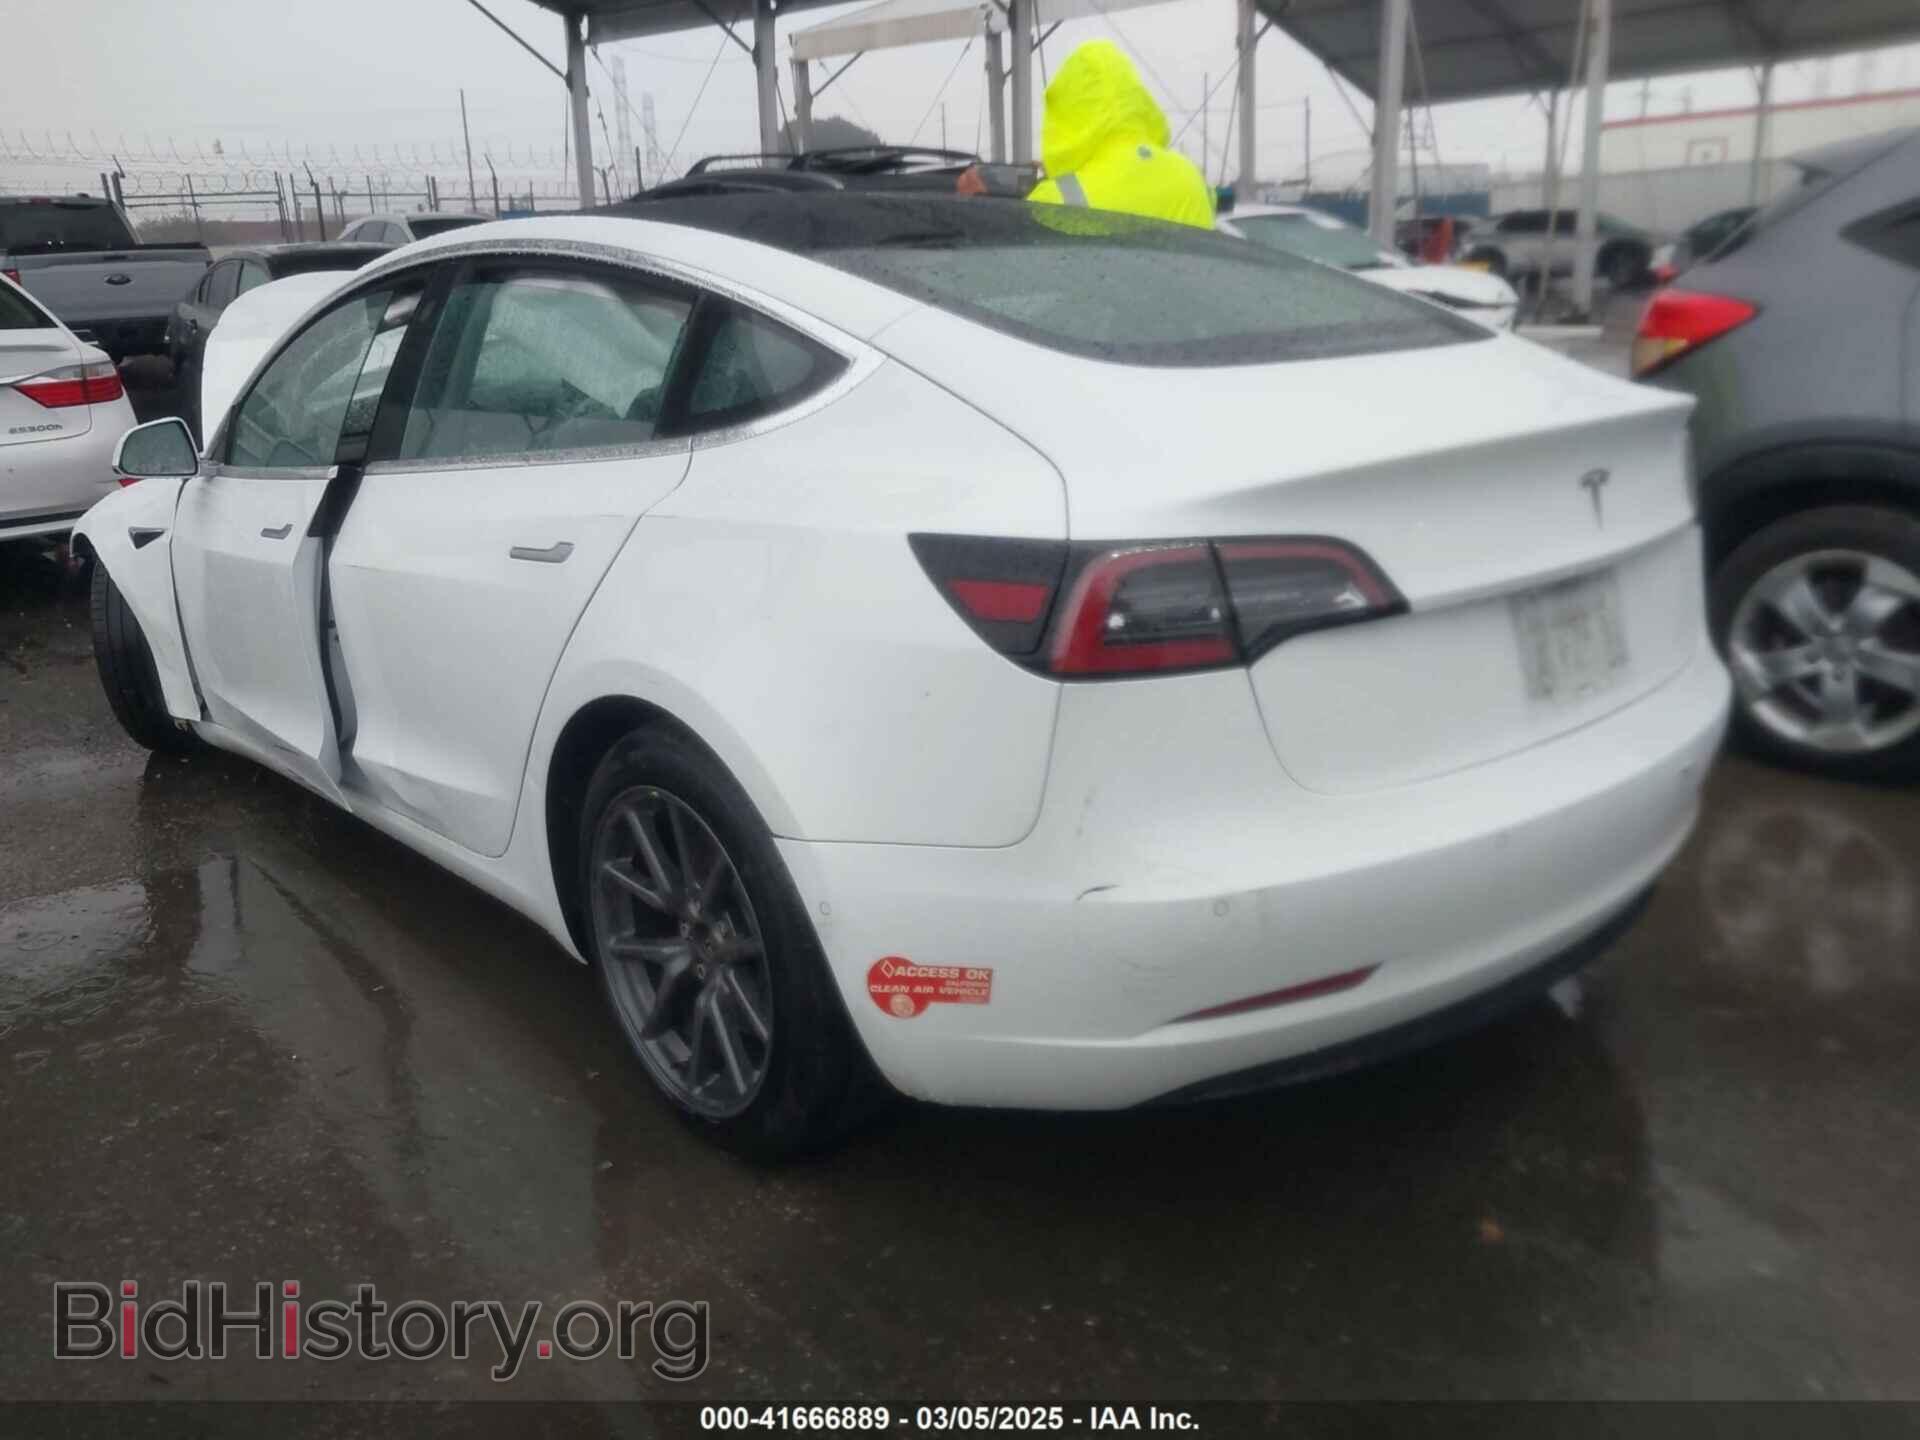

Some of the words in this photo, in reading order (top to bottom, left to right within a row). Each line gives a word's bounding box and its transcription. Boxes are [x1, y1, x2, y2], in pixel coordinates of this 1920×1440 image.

[894, 966, 960, 978] ACCESS
[966, 968, 989, 980] OK
[870, 984, 910, 993] CLEAN
[913, 985, 934, 994] AIR
[939, 986, 989, 996] VEHICLE
